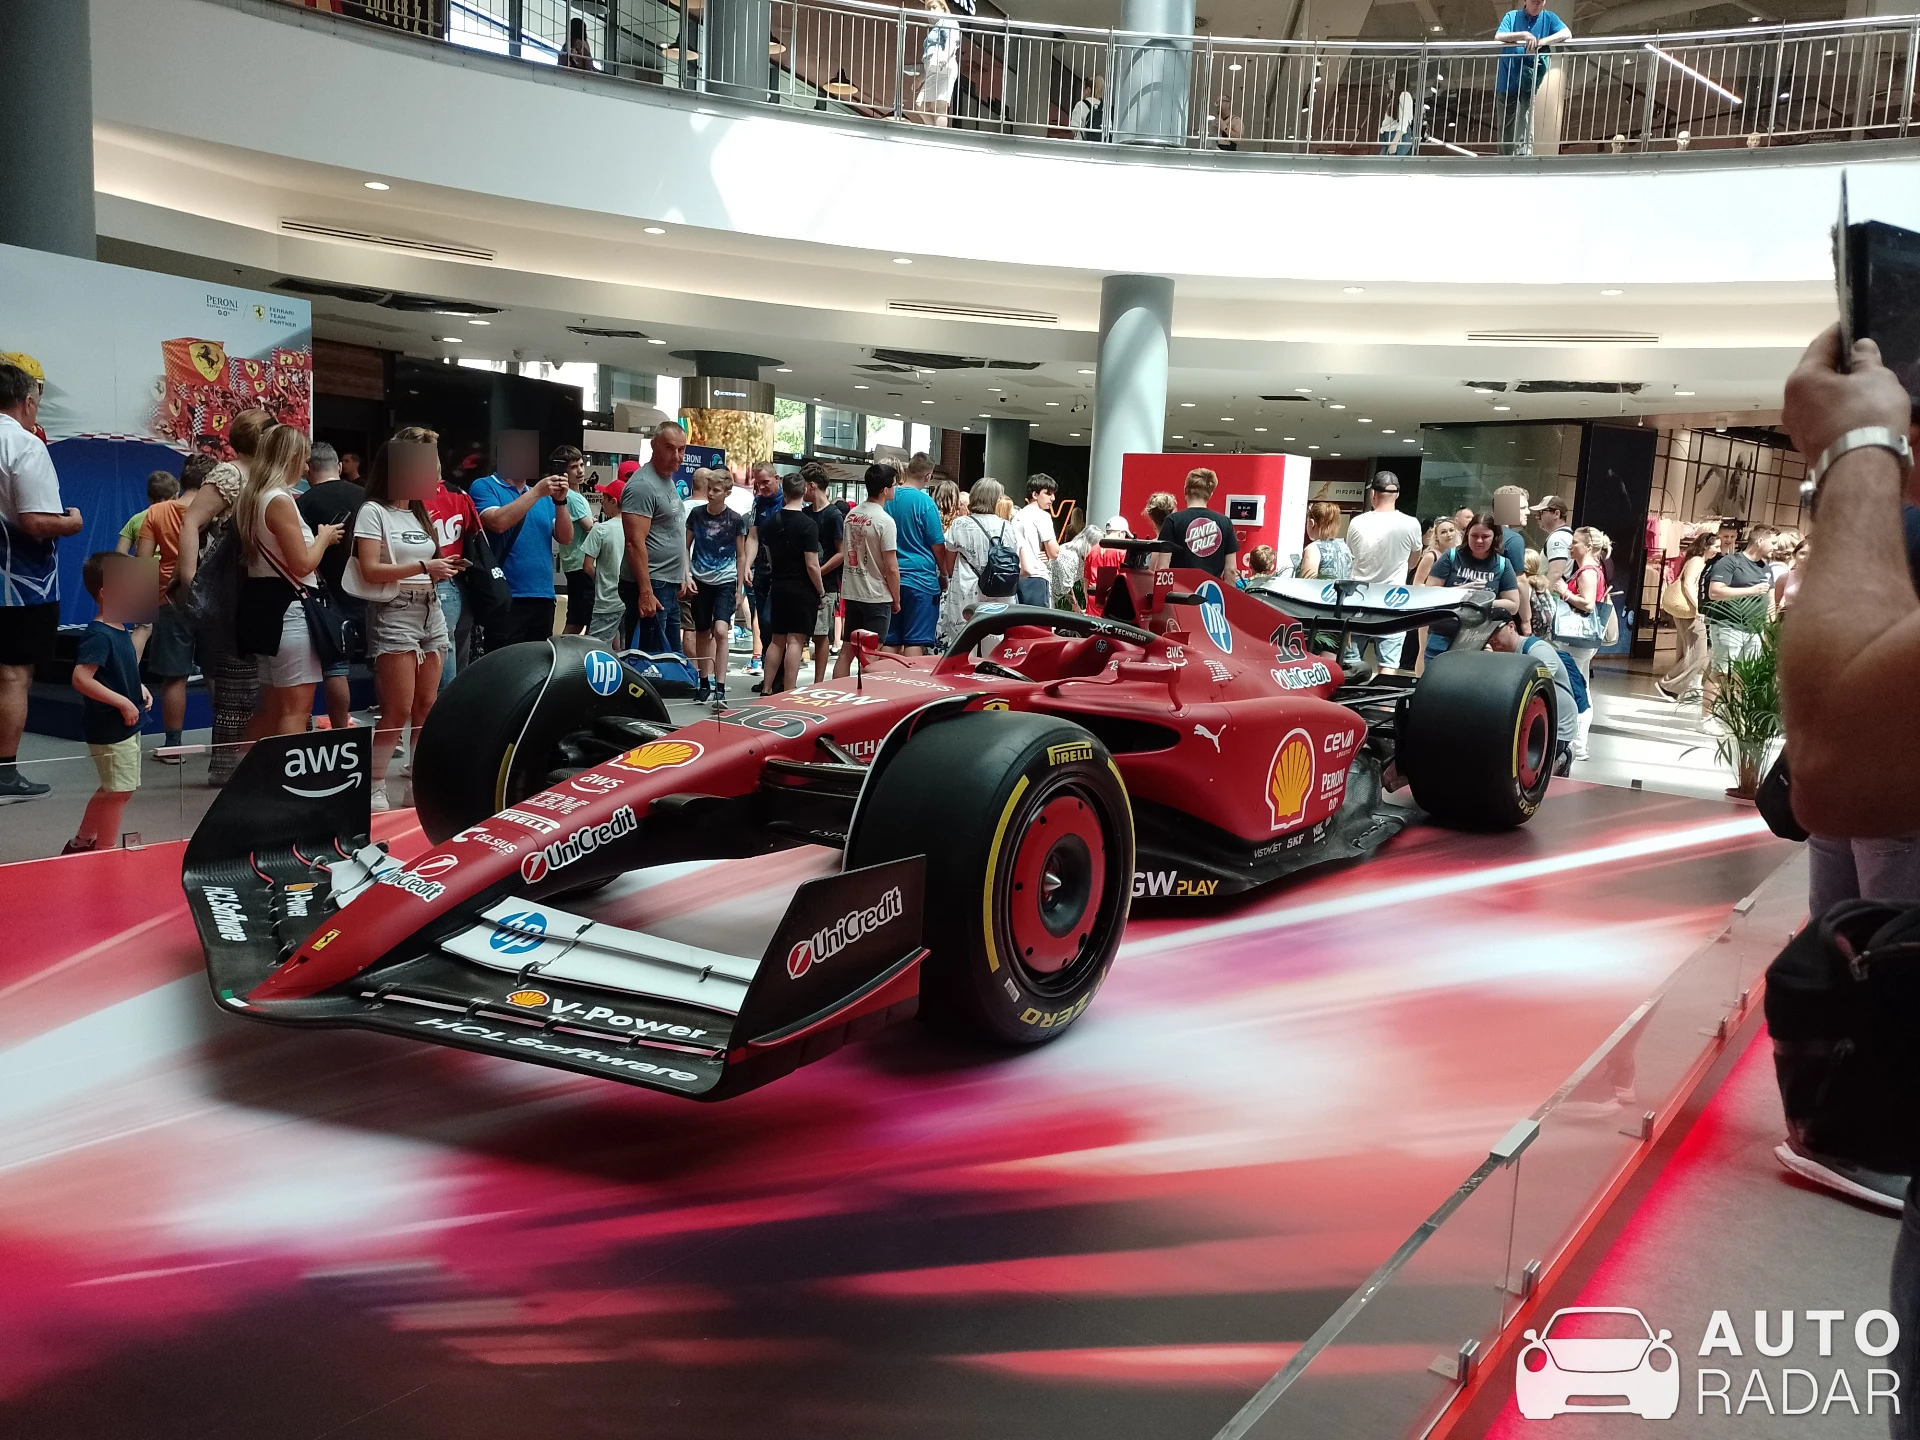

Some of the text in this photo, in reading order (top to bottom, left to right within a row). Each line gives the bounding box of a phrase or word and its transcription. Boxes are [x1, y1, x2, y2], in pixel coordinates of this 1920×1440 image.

[206, 294, 238, 309] PERONI
[269, 306, 295, 315] FERRARI
[269, 319, 297, 328] PARTNER
[682, 453, 702, 464] ERONI
[433, 514, 463, 547] 16
[1185, 521, 1217, 542] SANTA
[1191, 534, 1217, 553] CRUZ
[1156, 572, 1174, 585] ZCG
[1457, 566, 1494, 582] LIMITED
[1384, 587, 1410, 608] hp
[1090, 621, 1147, 642] DXC TECHNOLOGY
[1004, 647, 1027, 659] Ray-Ban
[1166, 646, 1184, 658] aws
[1270, 622, 1307, 663] 16
[584, 650, 623, 696] hp
[788, 686, 888, 706] VGW
[706, 705, 828, 739] 16
[285, 742, 359, 777] aws
[1047, 741, 1093, 766] PIRELLI
[579, 773, 625, 789] aws
[494, 809, 560, 834] PIRELLI
[473, 832, 518, 855] CELSIUS
[545, 804, 638, 870] UniCredit
[1287, 834, 1304, 849] SKF
[1132, 870, 1219, 896] GW PLAY
[490, 911, 548, 955] hp
[811, 885, 902, 963] UniCredit
[550, 998, 708, 1039] V-Power
[1020, 991, 1090, 1028] ZERO
